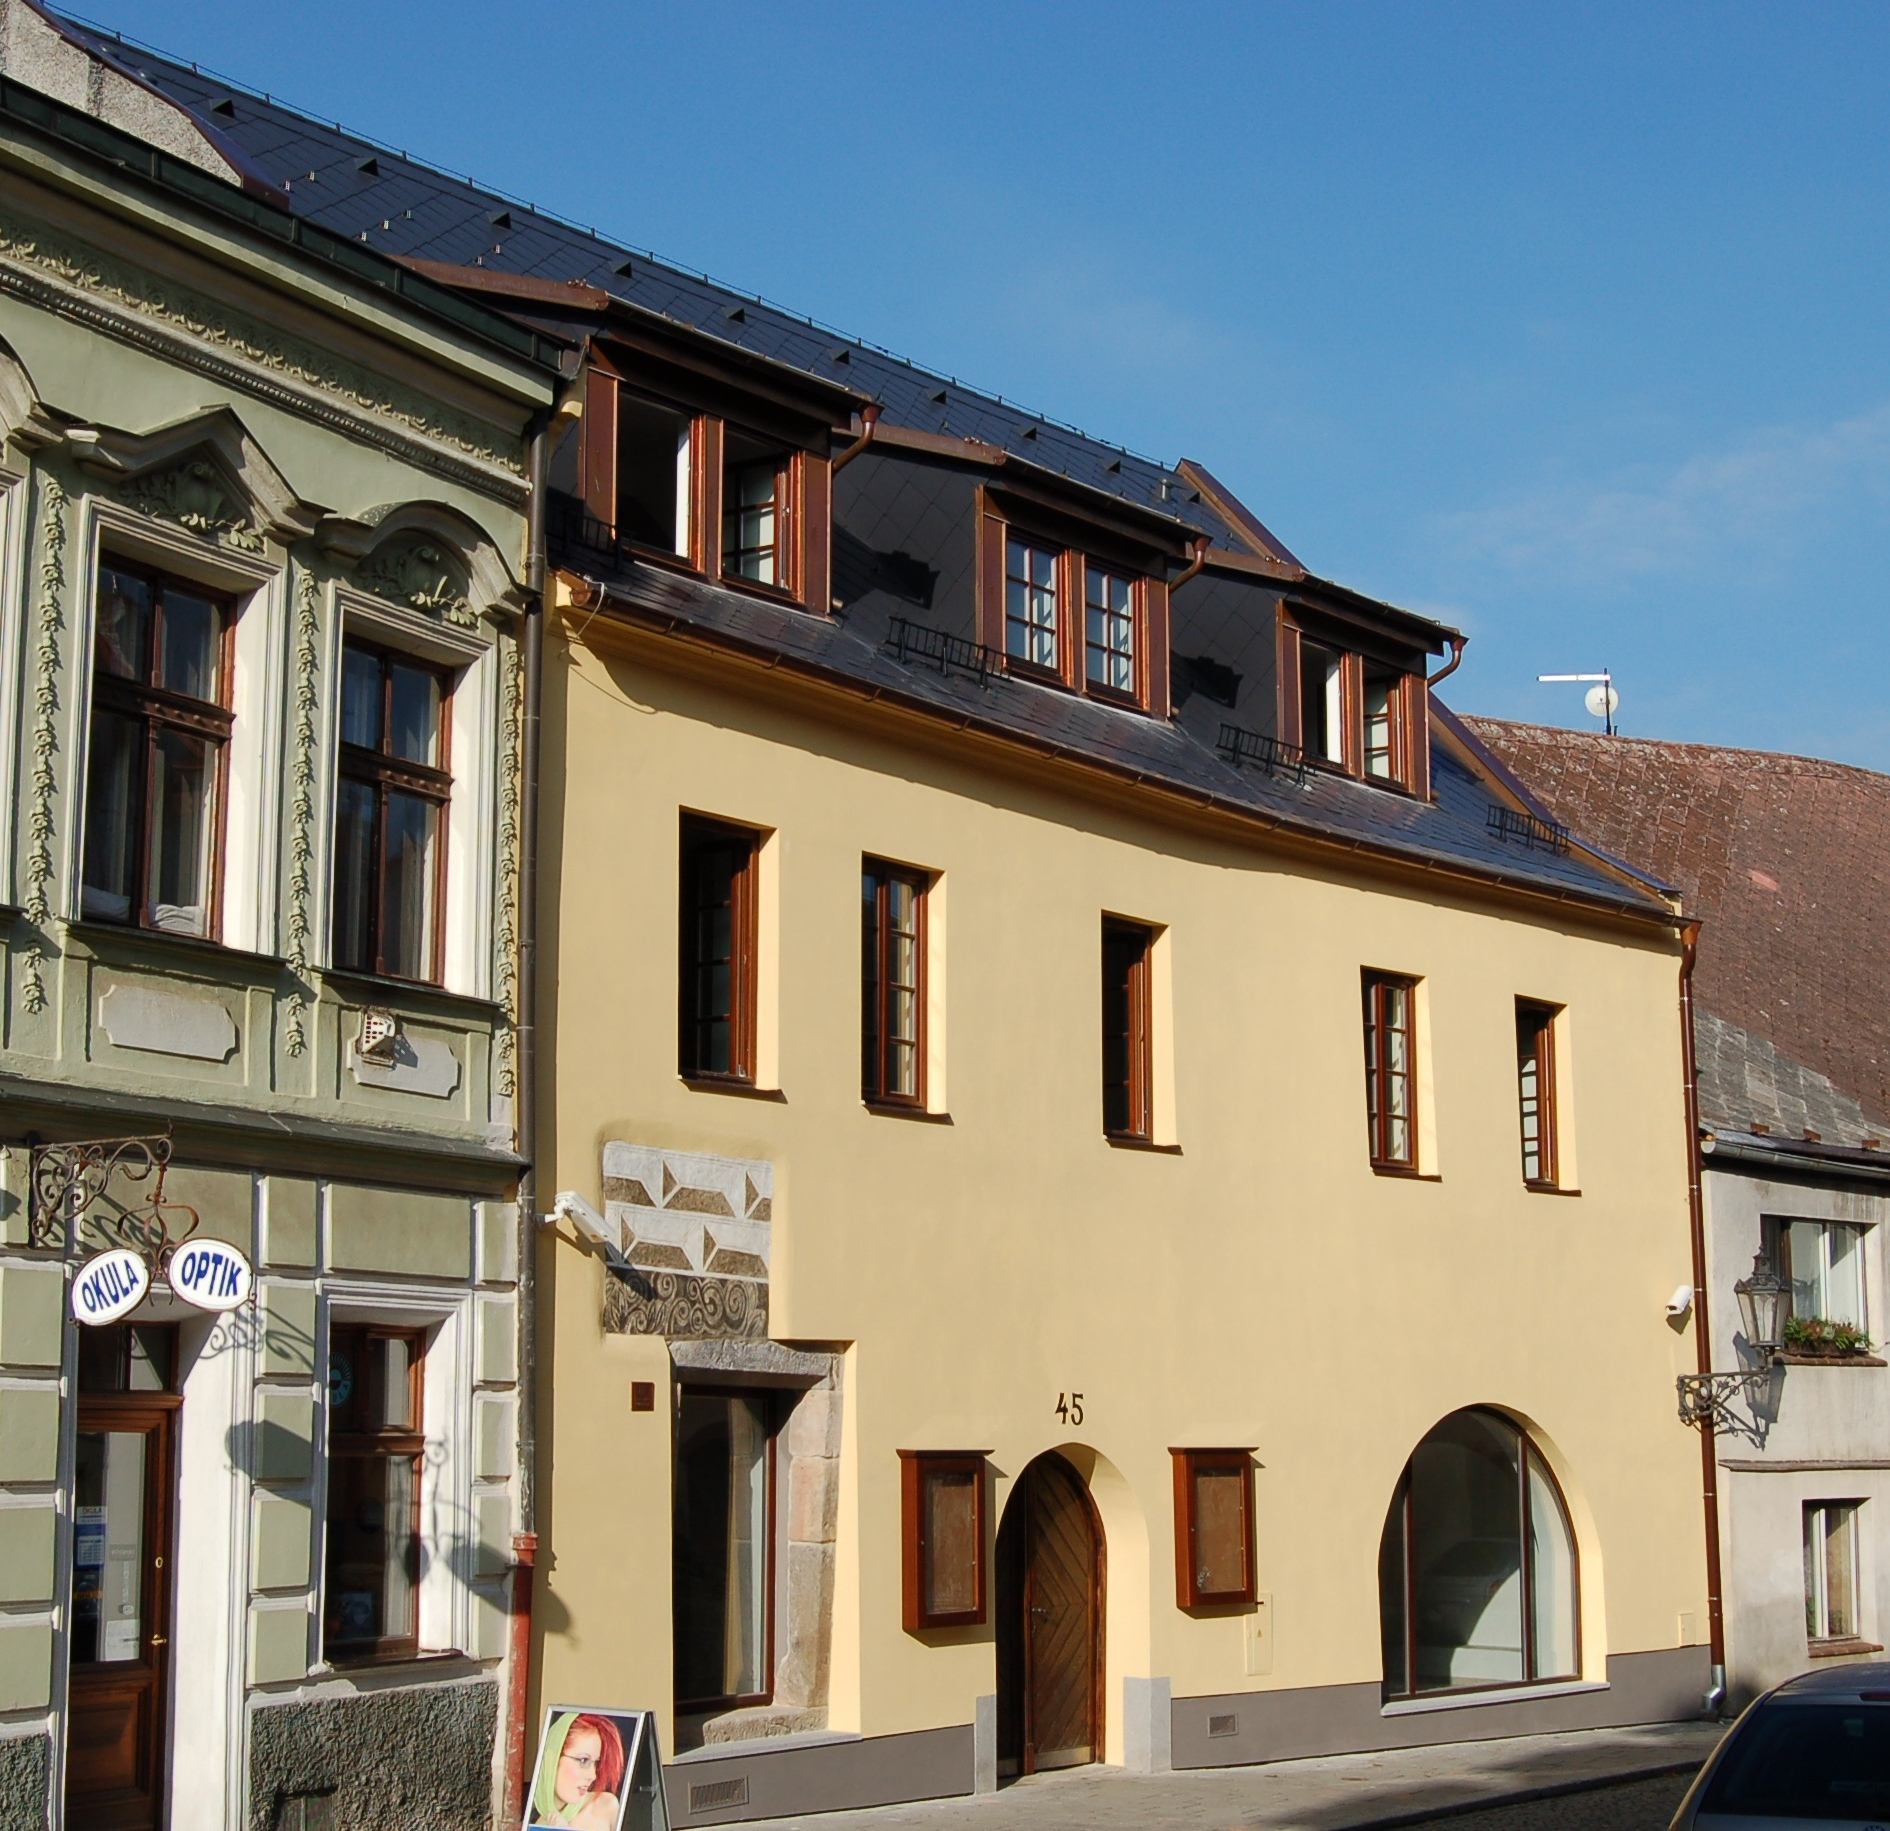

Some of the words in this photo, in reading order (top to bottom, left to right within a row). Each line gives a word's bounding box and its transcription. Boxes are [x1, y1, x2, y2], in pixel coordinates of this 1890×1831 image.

[81, 1259, 140, 1313] OKULA
[181, 1251, 242, 1297] OPTIK
[1054, 1391, 1084, 1426] 45
